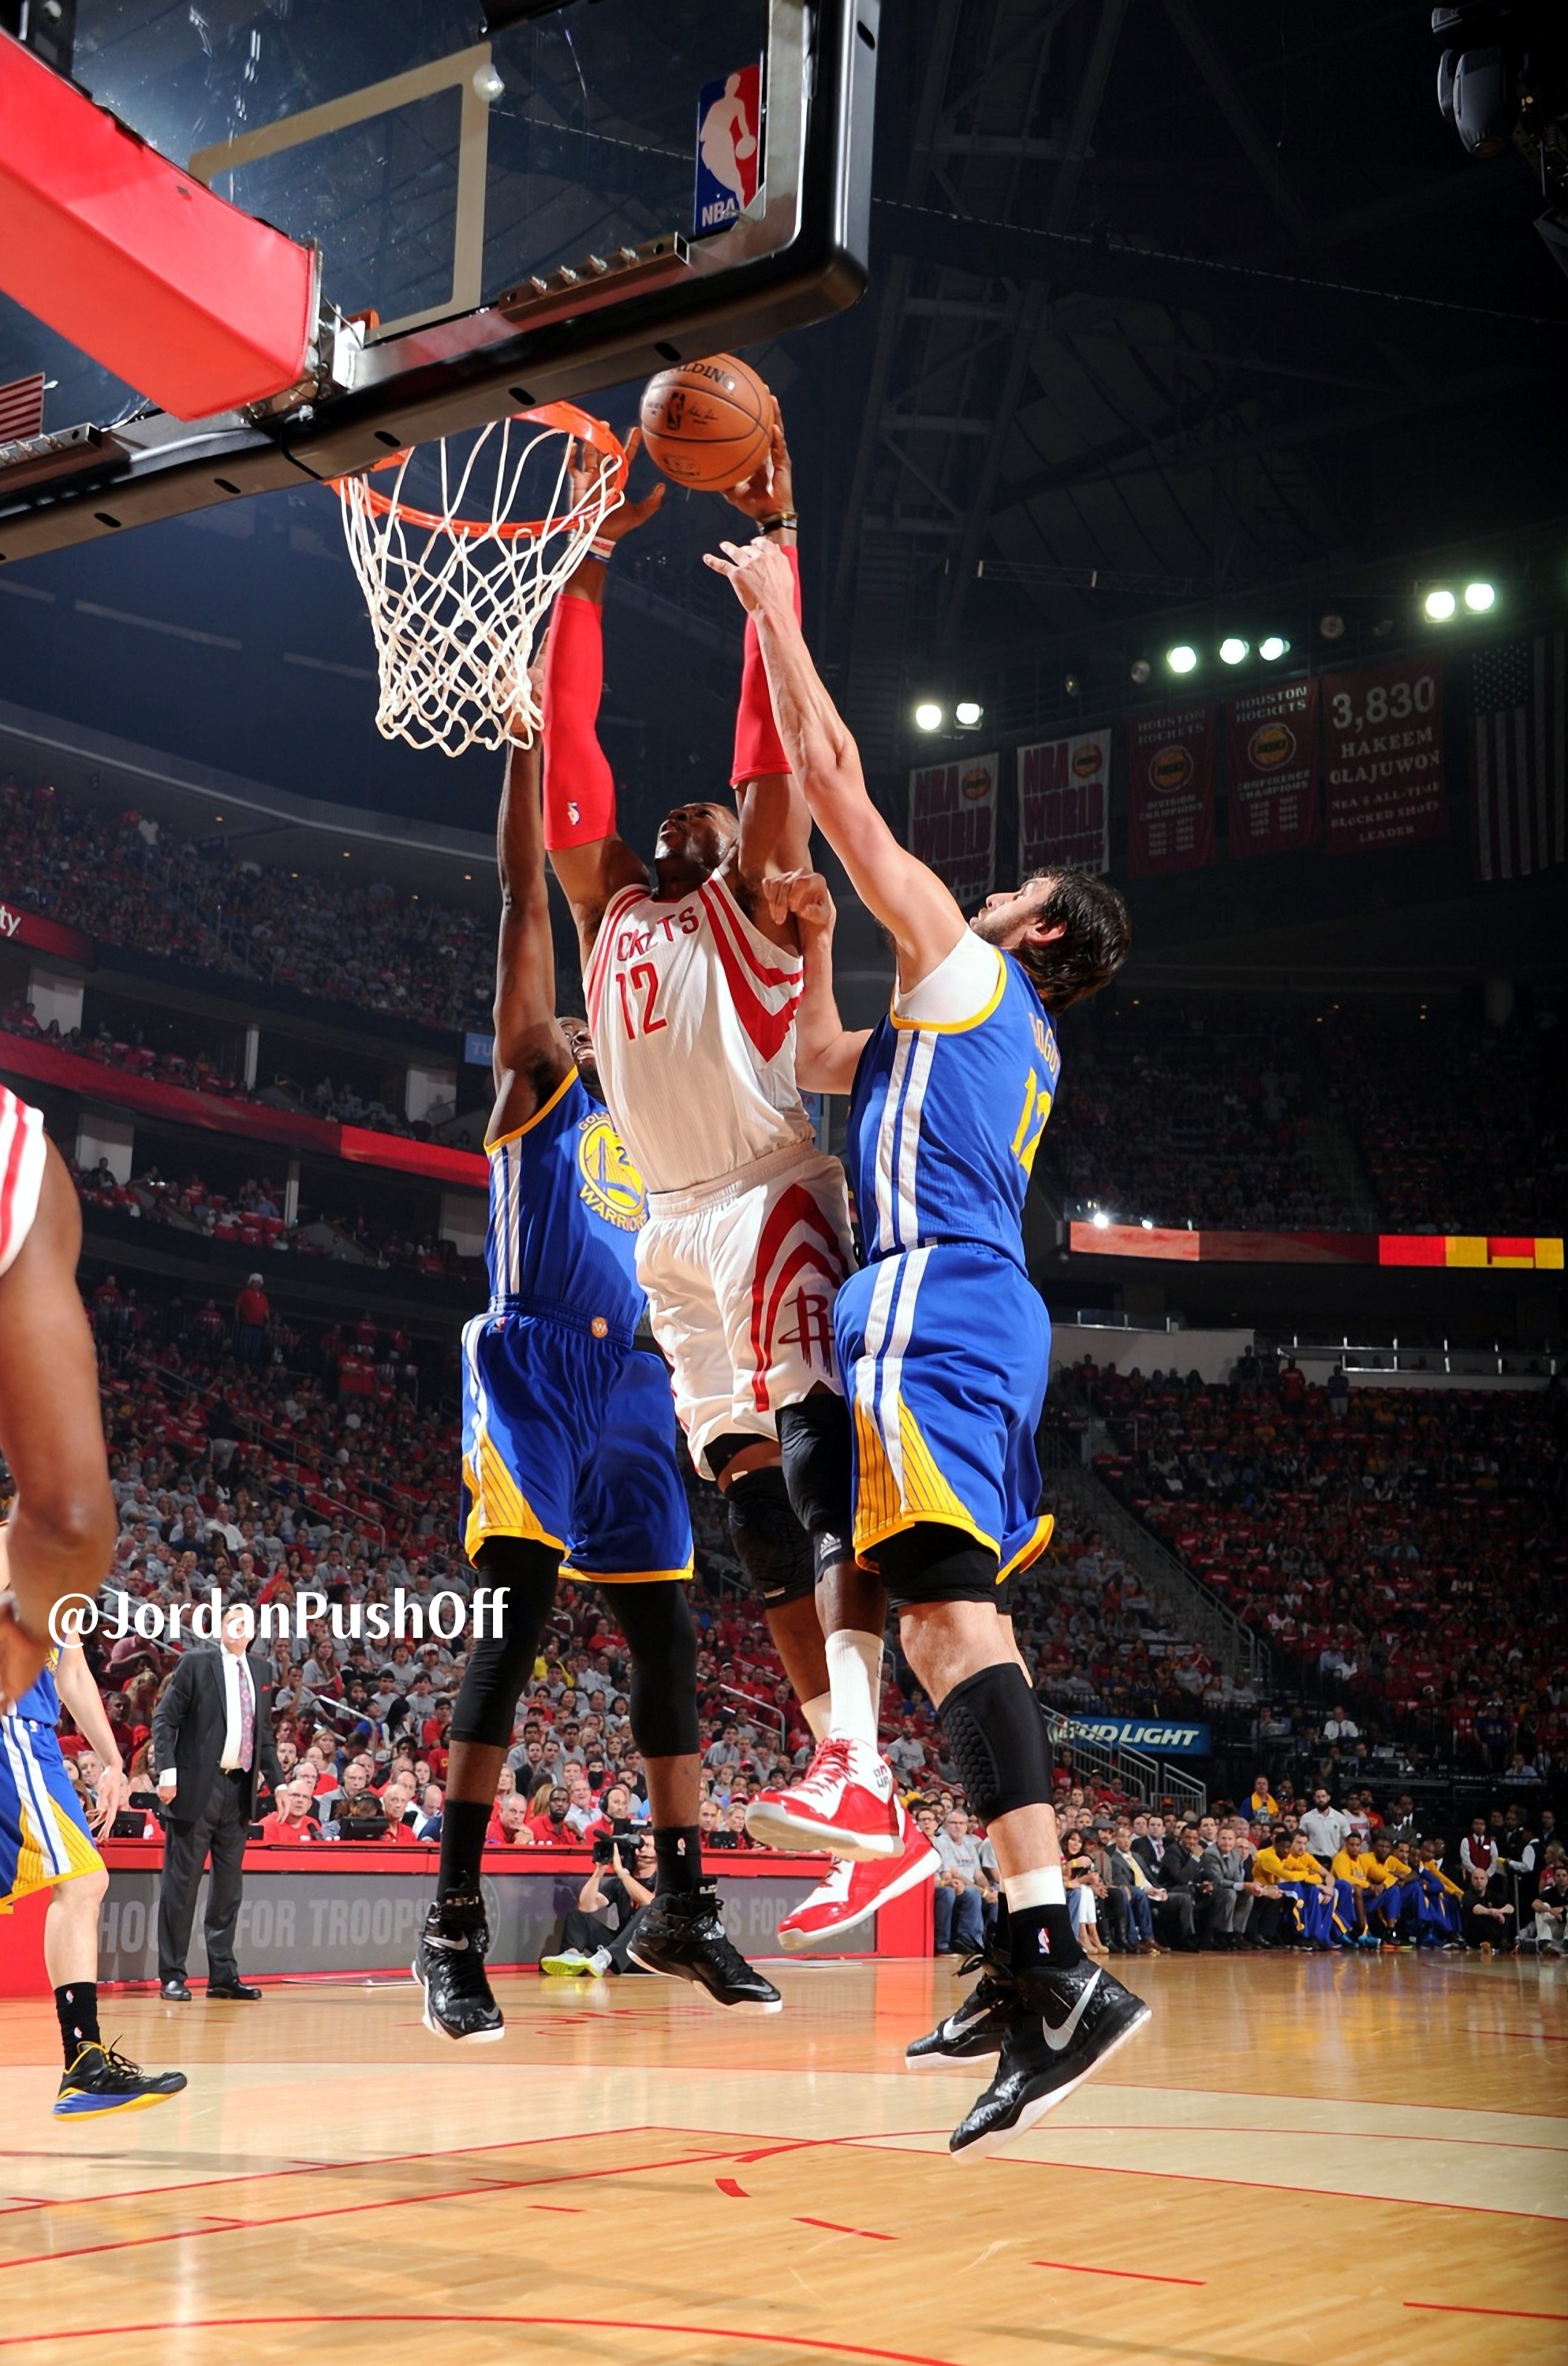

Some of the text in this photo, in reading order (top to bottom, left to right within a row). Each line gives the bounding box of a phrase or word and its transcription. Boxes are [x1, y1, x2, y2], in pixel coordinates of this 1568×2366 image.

[701, 197, 737, 227] NBA
[1235, 686, 1308, 711] HOUSTON
[1235, 699, 1307, 723] ROCKETS
[1332, 675, 1435, 734] 3,830
[1341, 726, 1433, 759] HAKEEM
[1329, 749, 1440, 785] OLAJUWON
[1331, 780, 1440, 809] NBA'S ALL-TIME
[1331, 801, 1439, 828] BLOCKED SHOTS
[1359, 824, 1415, 843] LEADER
[615, 962, 668, 1041] 12
[1010, 1067, 1052, 1177] 12
[1119, 1723, 1200, 1746] LIGHT
[234, 1899, 296, 1949] FOR
